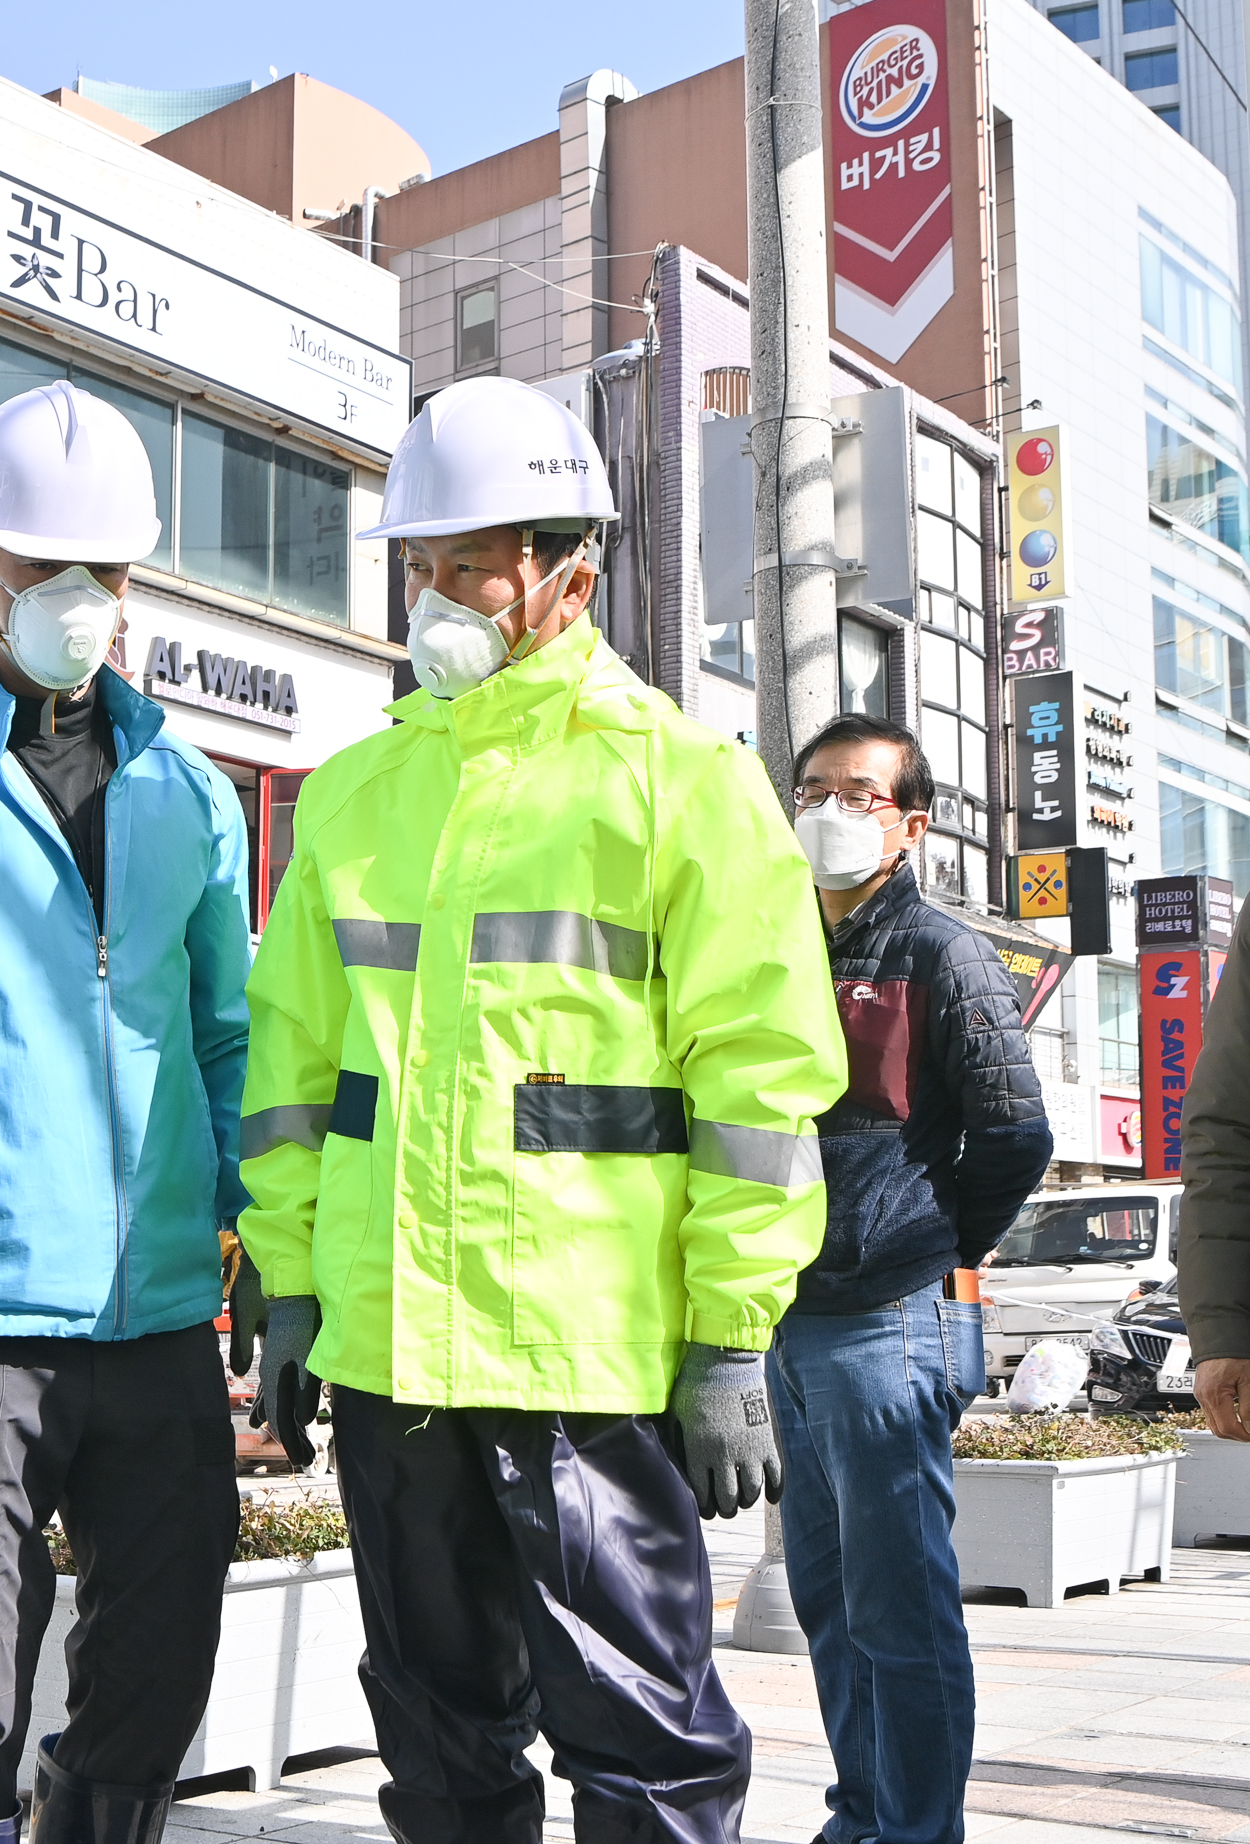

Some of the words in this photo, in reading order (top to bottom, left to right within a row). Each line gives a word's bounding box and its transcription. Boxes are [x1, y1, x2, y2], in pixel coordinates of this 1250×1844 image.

[853, 37, 921, 99] BURGER
[856, 53, 925, 124] KING
[840, 126, 941, 191] 버거킹
[289, 323, 356, 376] Modern
[362, 357, 393, 391] Bar
[337, 391, 358, 424] 3F
[528, 459, 589, 475] 해운대구
[1031, 572, 1047, 587] B1
[1009, 611, 1046, 650] S
[144, 636, 299, 714] AL-WAHA
[1004, 647, 1057, 673] BAR
[251, 709, 296, 730] 051-731-2015
[1143, 890, 1194, 905] LIBERO
[1145, 905, 1192, 918] HOTEL
[1145, 920, 1193, 934] 리베로호텔
[1160, 1019, 1186, 1090] SAVE
[1162, 1096, 1184, 1172] ZONE
